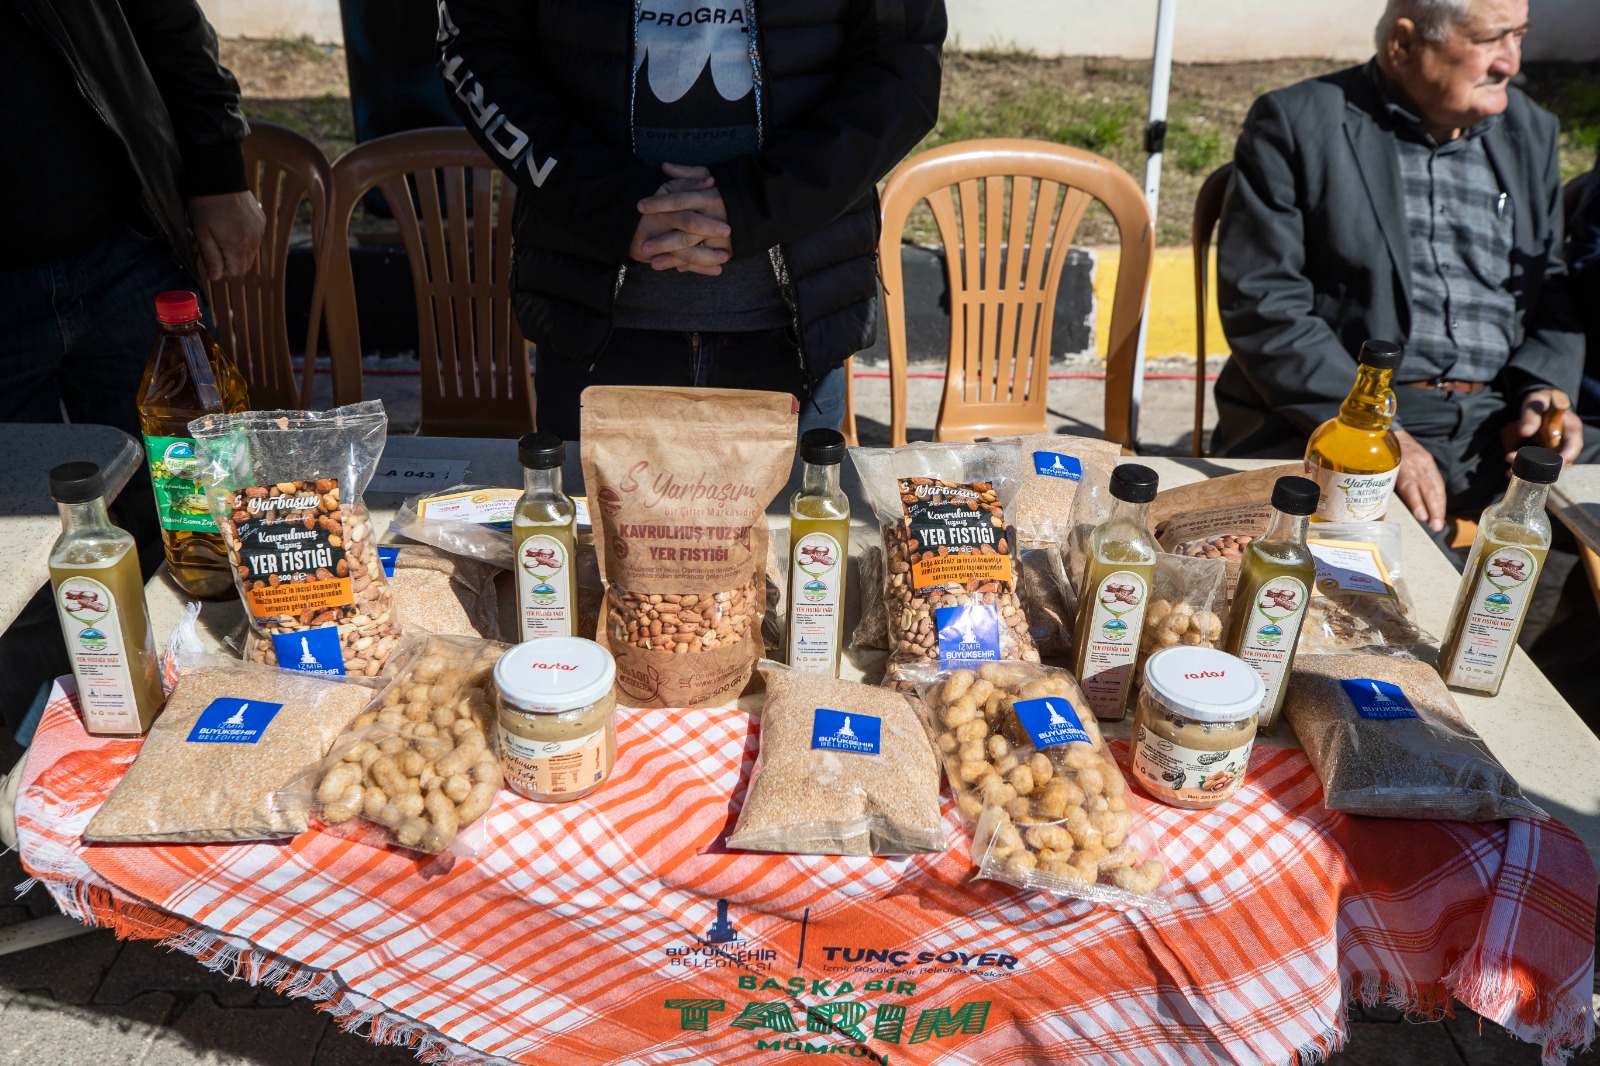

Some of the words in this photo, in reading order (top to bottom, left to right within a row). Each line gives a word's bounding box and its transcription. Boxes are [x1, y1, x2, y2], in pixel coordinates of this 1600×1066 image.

[638, 8, 744, 26] PROGRA
[620, 460, 648, 492] S
[644, 472, 757, 508] Yarbaşım
[902, 482, 909, 492] S
[235, 495, 242, 507] S
[664, 508, 678, 516] Bir
[928, 508, 982, 520] Kavrulmuş
[258, 528, 318, 543] Kavrulmuş
[620, 524, 704, 543] KAVRULMUŞ
[707, 526, 750, 540] TUZSU
[920, 529, 946, 546] YER
[950, 523, 994, 545] FISTIĞI
[650, 546, 678, 560] YER
[680, 544, 728, 561] FISTIĞI
[250, 554, 278, 575] YER
[281, 544, 333, 572] FISTIĞI
[946, 650, 994, 659] BÜYÜKŞEHİR
[532, 662, 580, 671] rastas
[1184, 670, 1226, 680] rastas
[713, 684, 730, 697] 500
[1049, 722, 1074, 730] İZMİR
[819, 736, 874, 748] BÜYÜKŞEHİR
[820, 742, 872, 752] BELEDİYESİ
[671, 958, 771, 971] BELEDİYESİ
[822, 947, 910, 967] TUNÇ
[916, 951, 1019, 970] SOYER
[824, 964, 849, 972] İzmir
[738, 975, 854, 997] BAŞKA
[864, 977, 917, 997] BİR
[664, 999, 992, 1045] TARIM
[757, 1039, 888, 1066] MÜMKÜN
